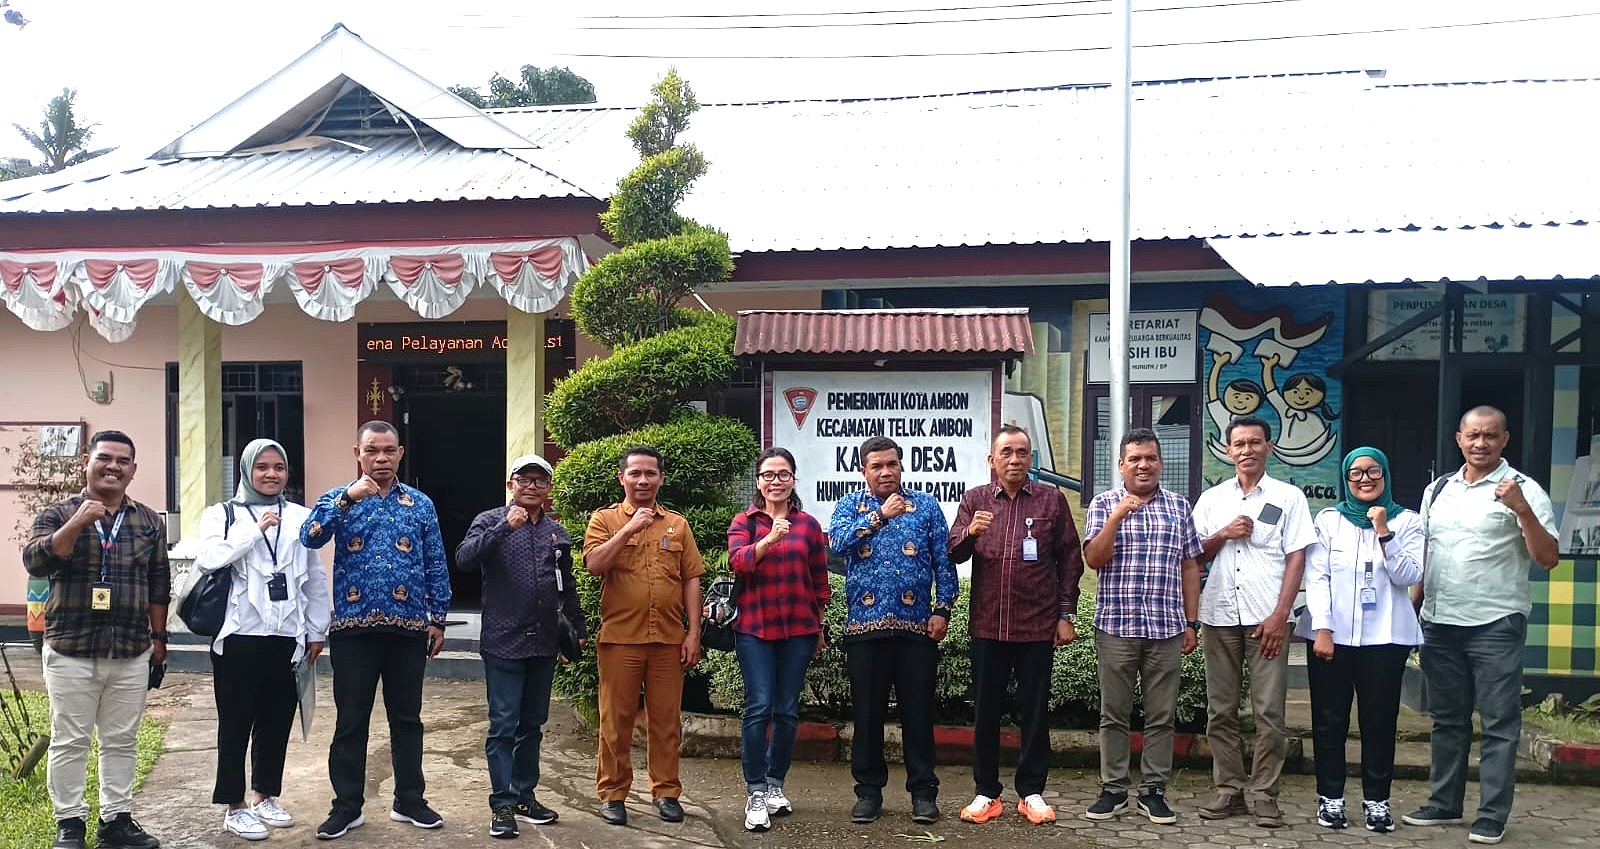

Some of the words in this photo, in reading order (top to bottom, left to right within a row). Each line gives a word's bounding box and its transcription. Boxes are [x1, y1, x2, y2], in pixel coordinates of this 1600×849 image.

[367, 339, 393, 350] ena
[402, 336, 483, 353] Pelayanan
[1155, 346, 1177, 358] IBU
[827, 392, 899, 410] PEMERINTAH
[900, 392, 929, 410] KOTA
[930, 392, 969, 410] AMBON
[816, 418, 885, 437] KECAMATAN
[888, 418, 927, 437] TELUK
[929, 418, 972, 437] AMBON
[911, 446, 957, 472] DESA
[926, 482, 966, 502] PATAH
